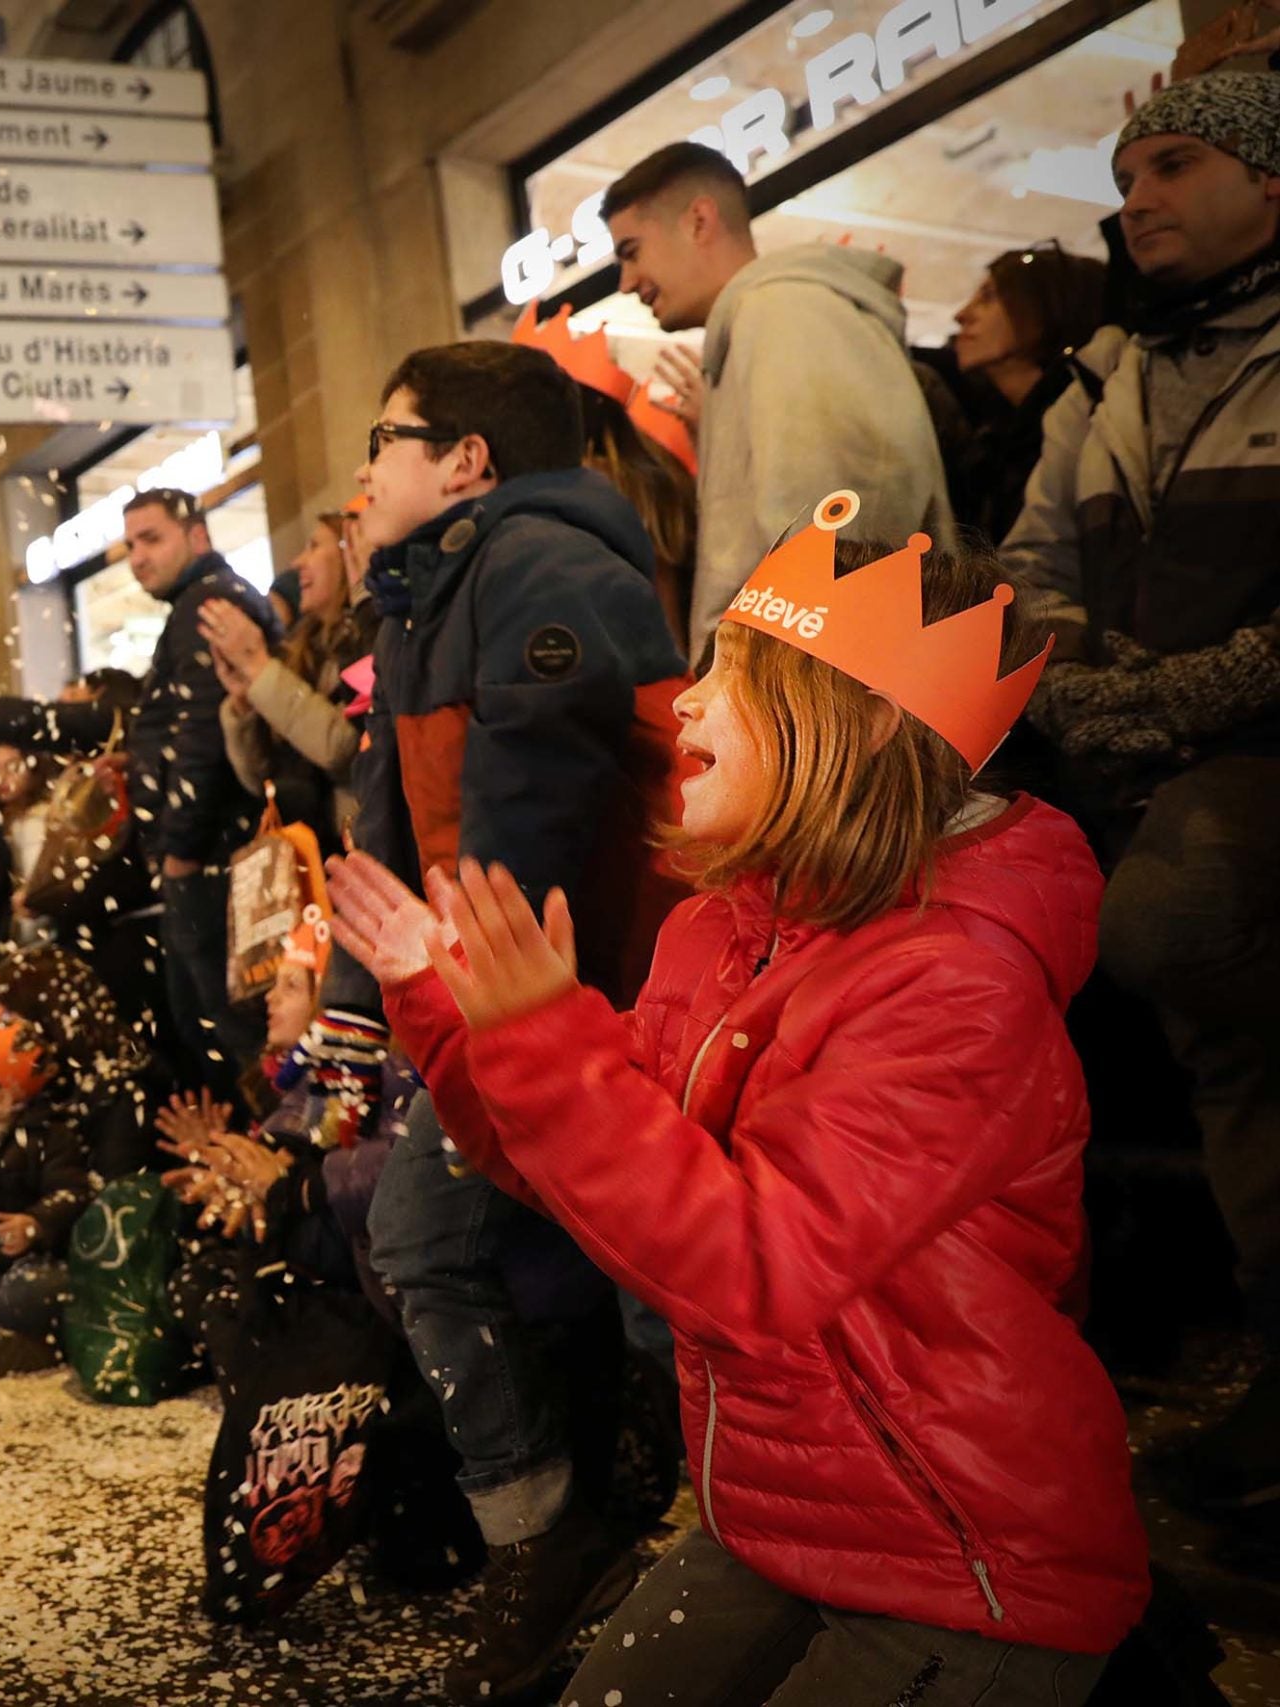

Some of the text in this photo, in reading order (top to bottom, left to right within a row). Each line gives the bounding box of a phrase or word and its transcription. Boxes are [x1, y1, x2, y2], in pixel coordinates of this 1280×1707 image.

[19, 67, 117, 98] Jaume
[19, 274, 113, 302] Marès
[23, 336, 172, 367] d'Història
[2, 371, 96, 400] Ciutat
